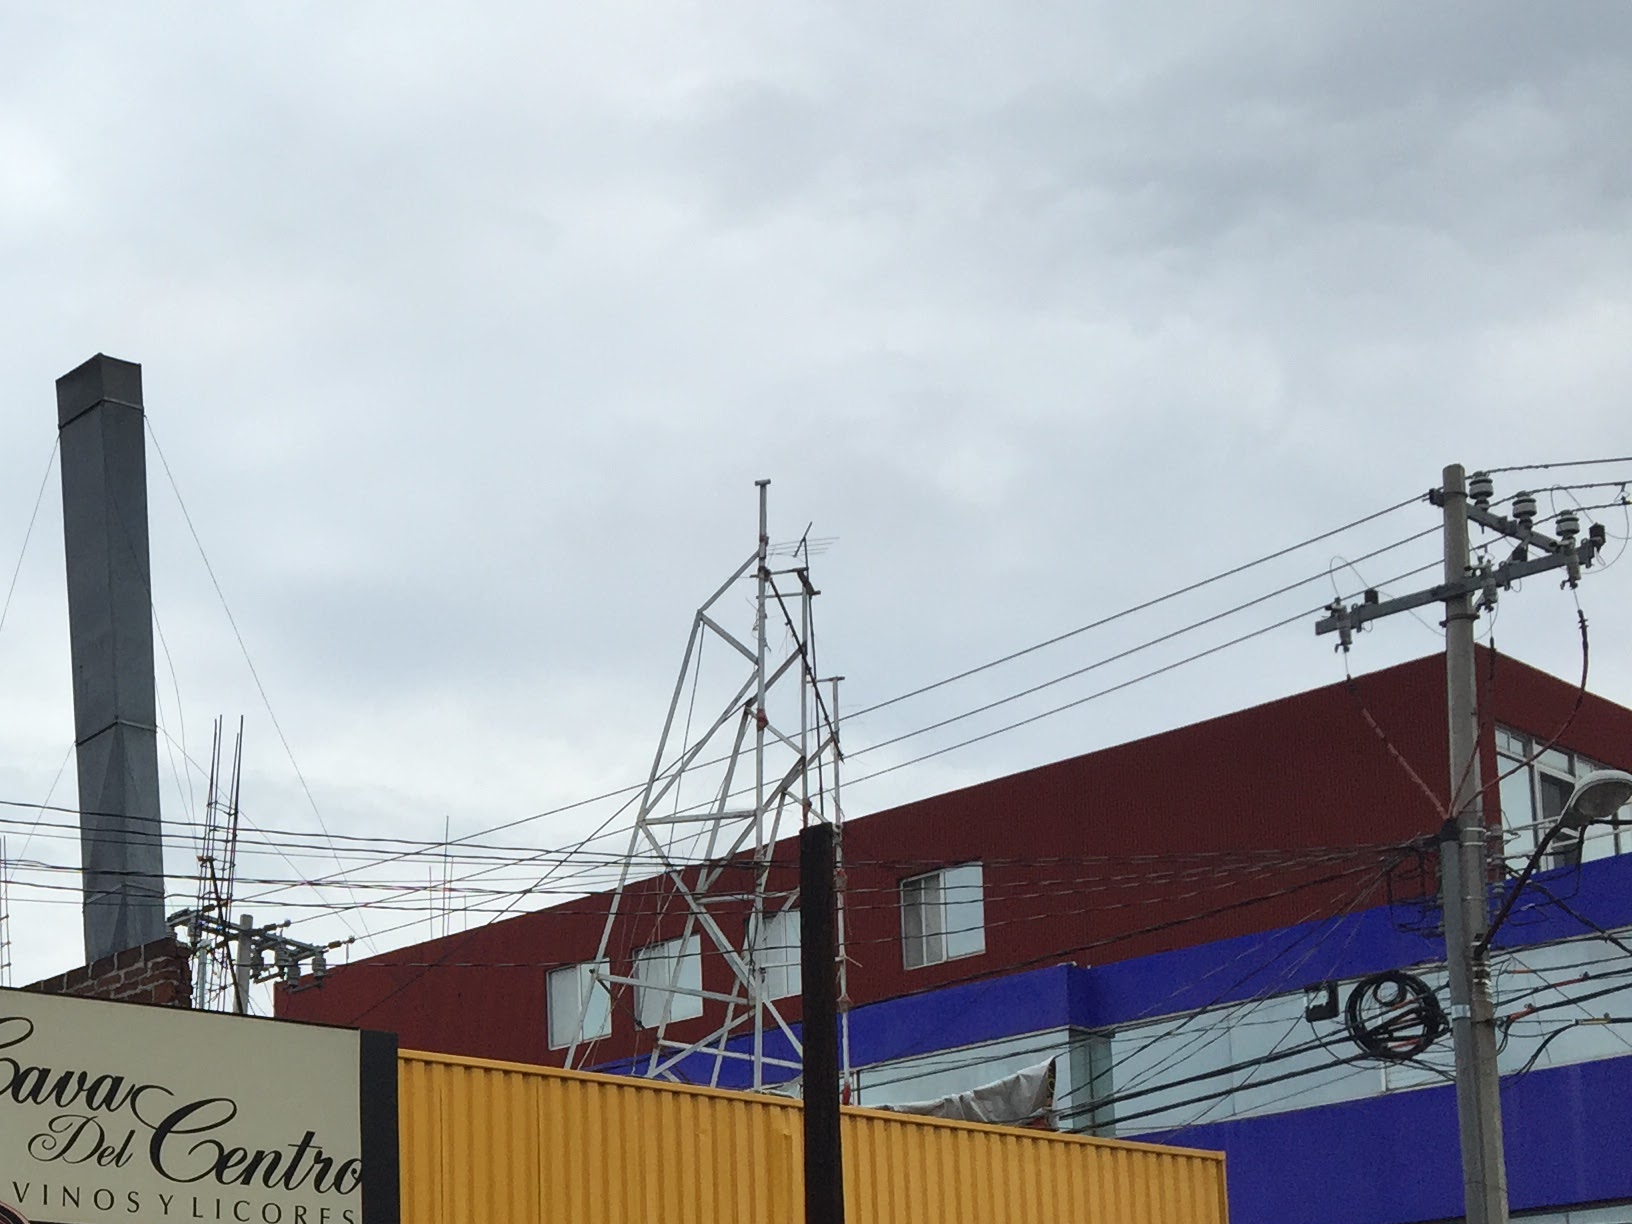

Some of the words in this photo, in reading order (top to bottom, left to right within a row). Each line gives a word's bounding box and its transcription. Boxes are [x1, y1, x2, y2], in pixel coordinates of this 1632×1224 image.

[27, 1114, 137, 1168] Del
[130, 1084, 363, 1195] Centro
[12, 1181, 141, 1215] VINOS
[159, 1194, 175, 1216] Y
